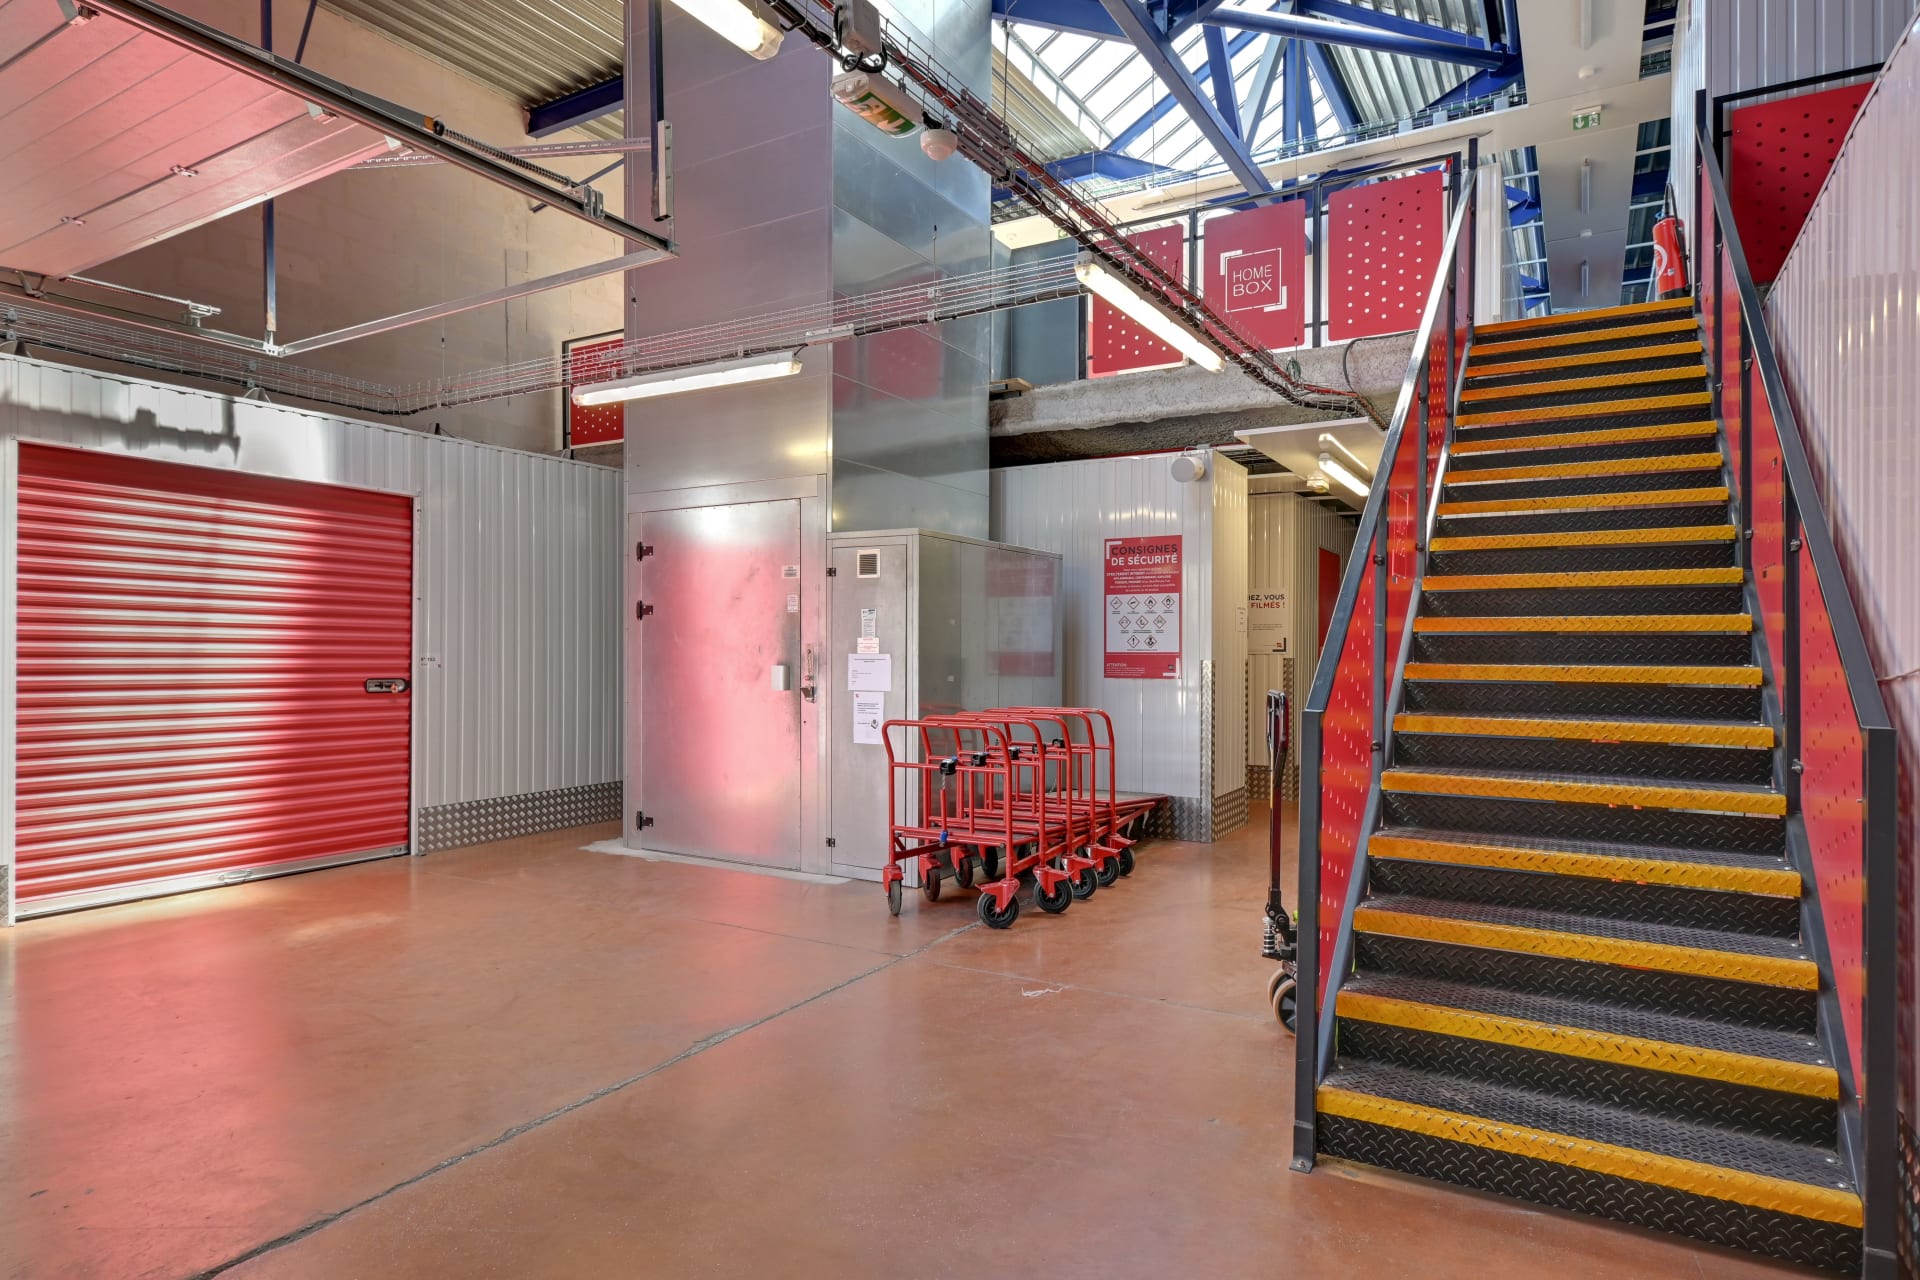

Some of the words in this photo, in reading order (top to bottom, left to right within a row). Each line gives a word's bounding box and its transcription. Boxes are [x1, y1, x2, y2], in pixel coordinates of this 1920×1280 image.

[1233, 264, 1272, 283] HOME
[1233, 278, 1272, 297] BOX
[1111, 544, 1178, 556] CONSIGNES
[1111, 557, 1125, 566] DE
[1127, 553, 1178, 565] SÉCURITÉ
